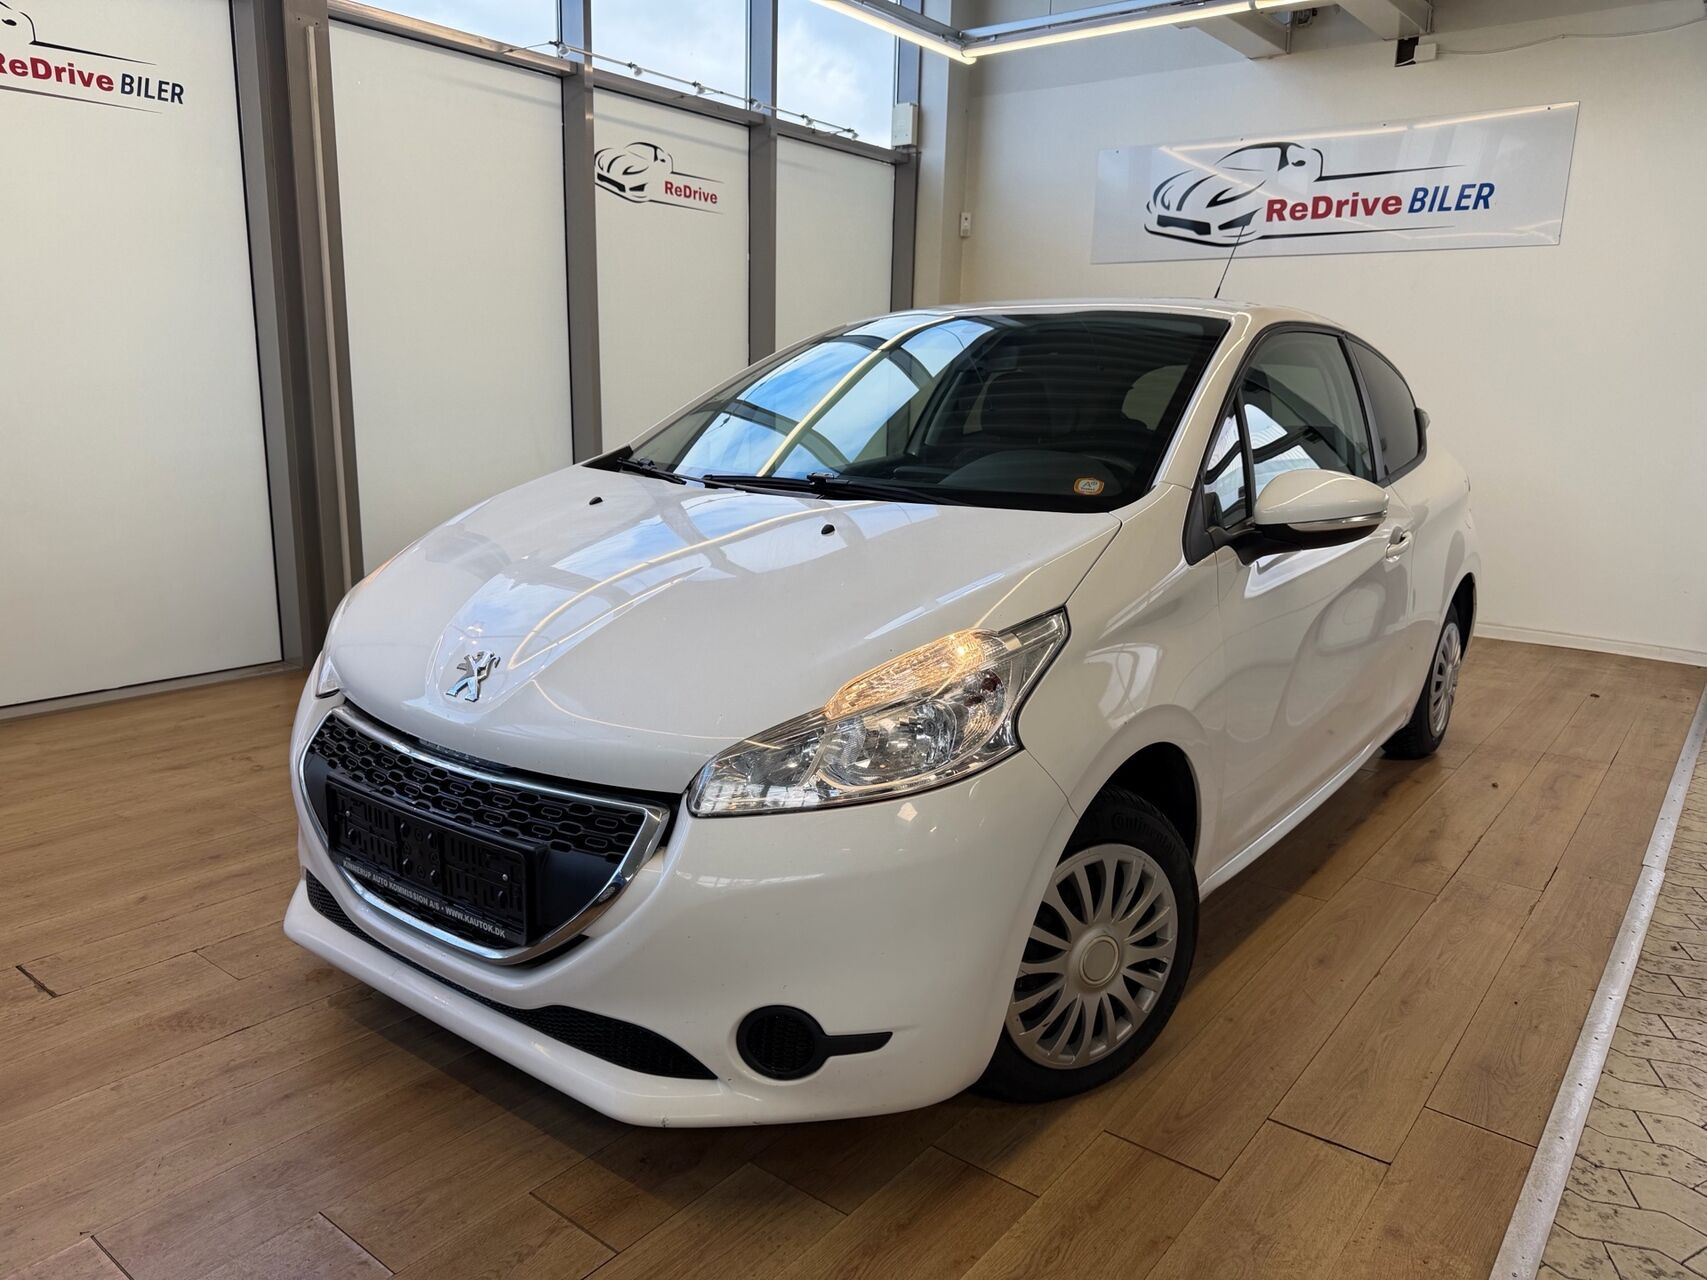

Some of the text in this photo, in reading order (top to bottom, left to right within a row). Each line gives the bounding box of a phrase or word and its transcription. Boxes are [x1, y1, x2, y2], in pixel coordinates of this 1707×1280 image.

[120, 73, 184, 104] BILER
[664, 180, 718, 204] ReDrive
[1265, 182, 1495, 222] ReDrive BILER
[372, 872, 388, 888] AUTO
[388, 882, 428, 907] KOMMISSION
[429, 899, 440, 912] A/S
[445, 905, 506, 939] WWW.KAUTOK.DK
